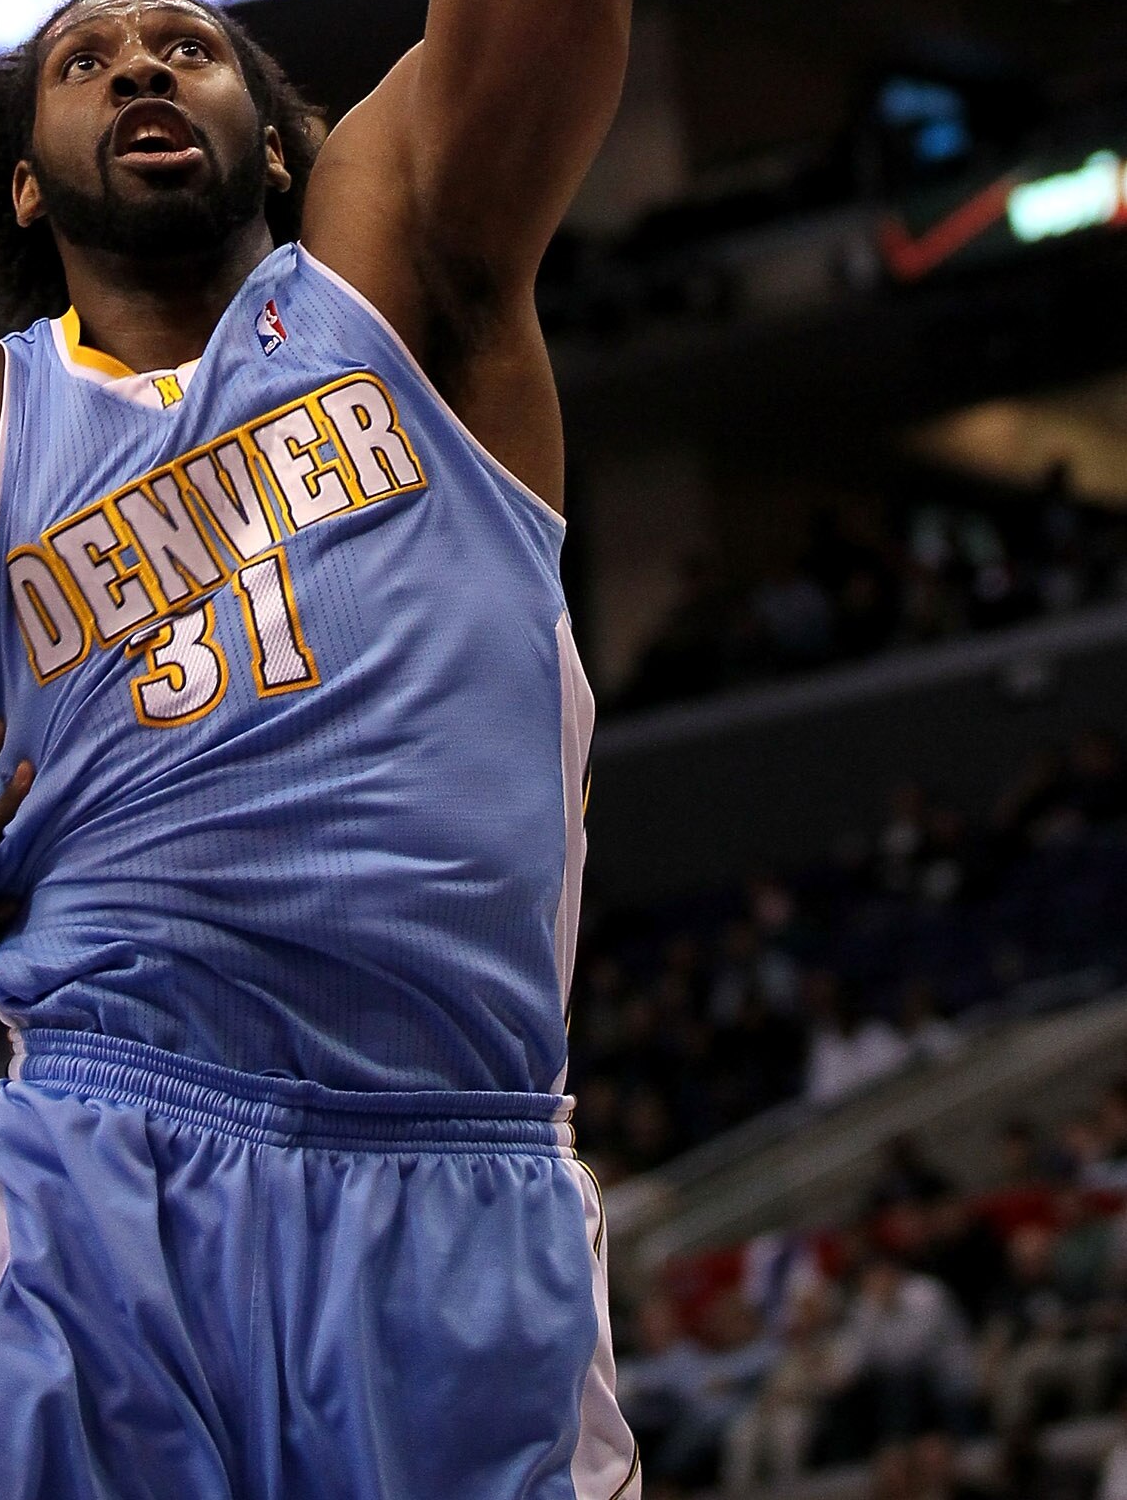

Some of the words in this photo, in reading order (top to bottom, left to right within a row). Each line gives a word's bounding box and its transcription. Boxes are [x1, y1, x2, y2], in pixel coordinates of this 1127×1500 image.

[151, 374, 184, 409] N
[6, 372, 429, 686] DENVER
[124, 545, 321, 728] 31
